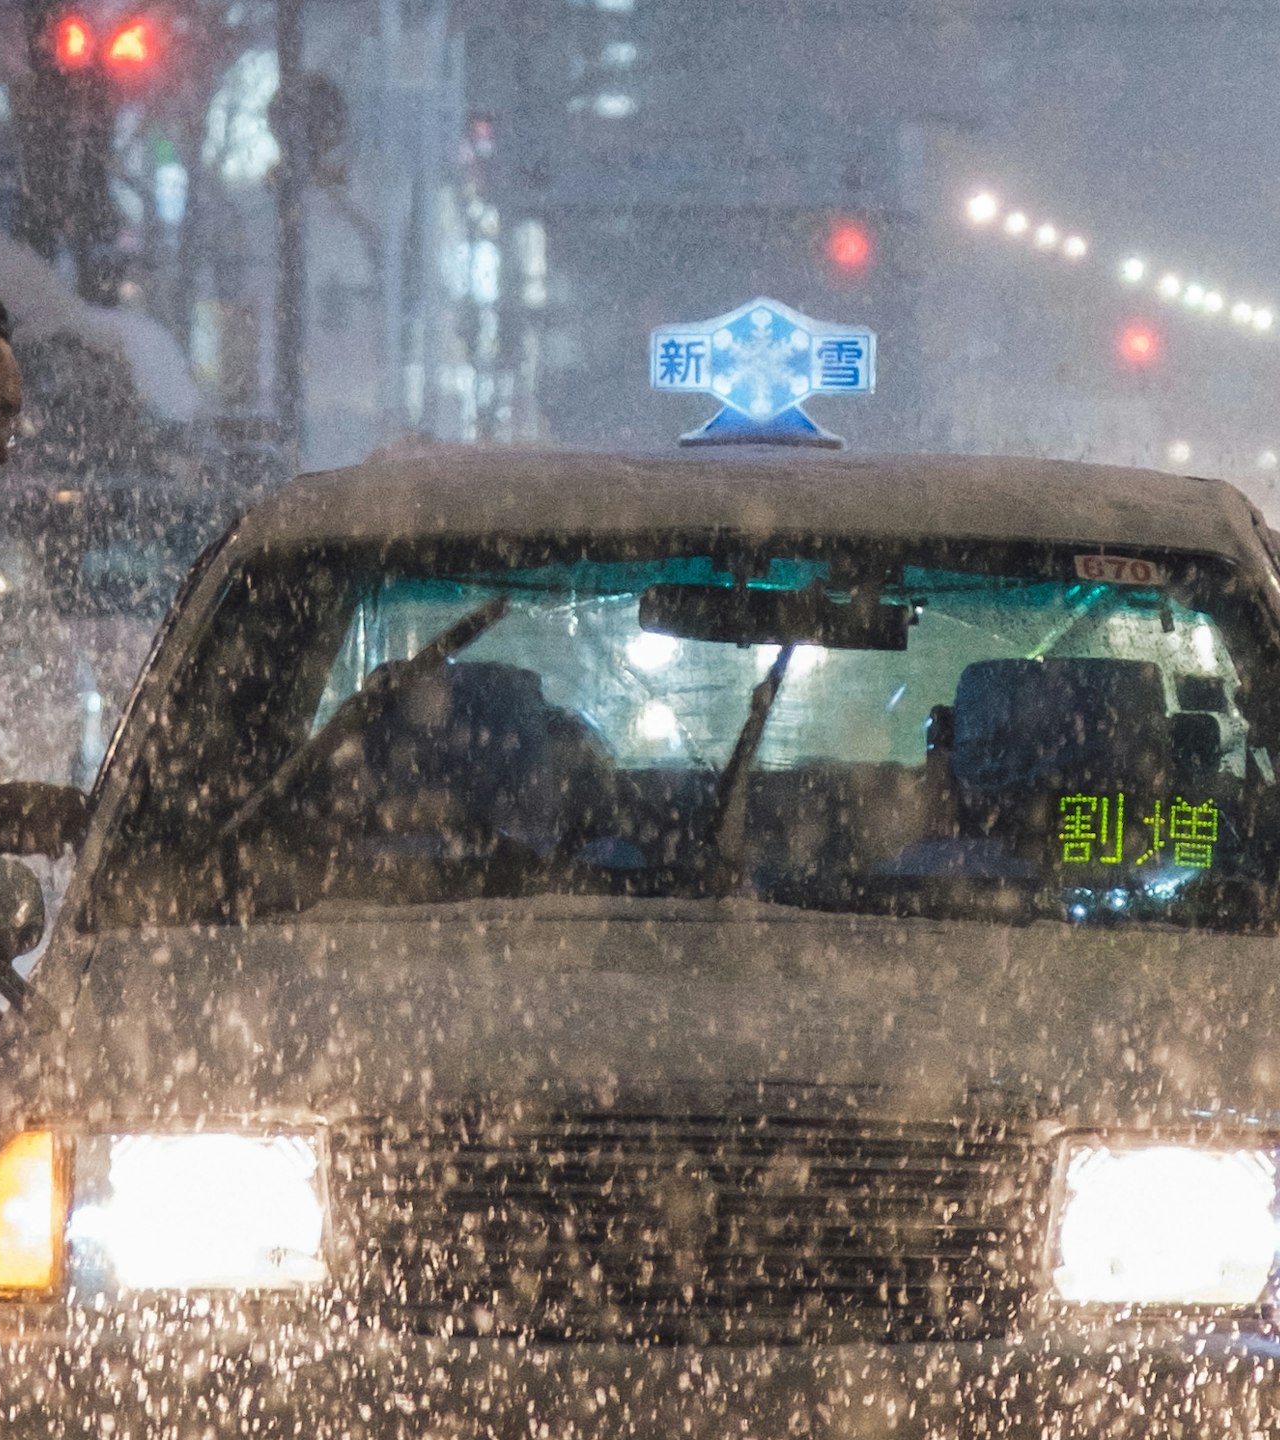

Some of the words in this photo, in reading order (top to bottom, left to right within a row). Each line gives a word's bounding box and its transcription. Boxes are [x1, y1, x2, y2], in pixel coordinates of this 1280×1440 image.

[659, 338, 706, 385] 新
[817, 339, 864, 388] 雪
[1058, 792, 1219, 869] 割増
